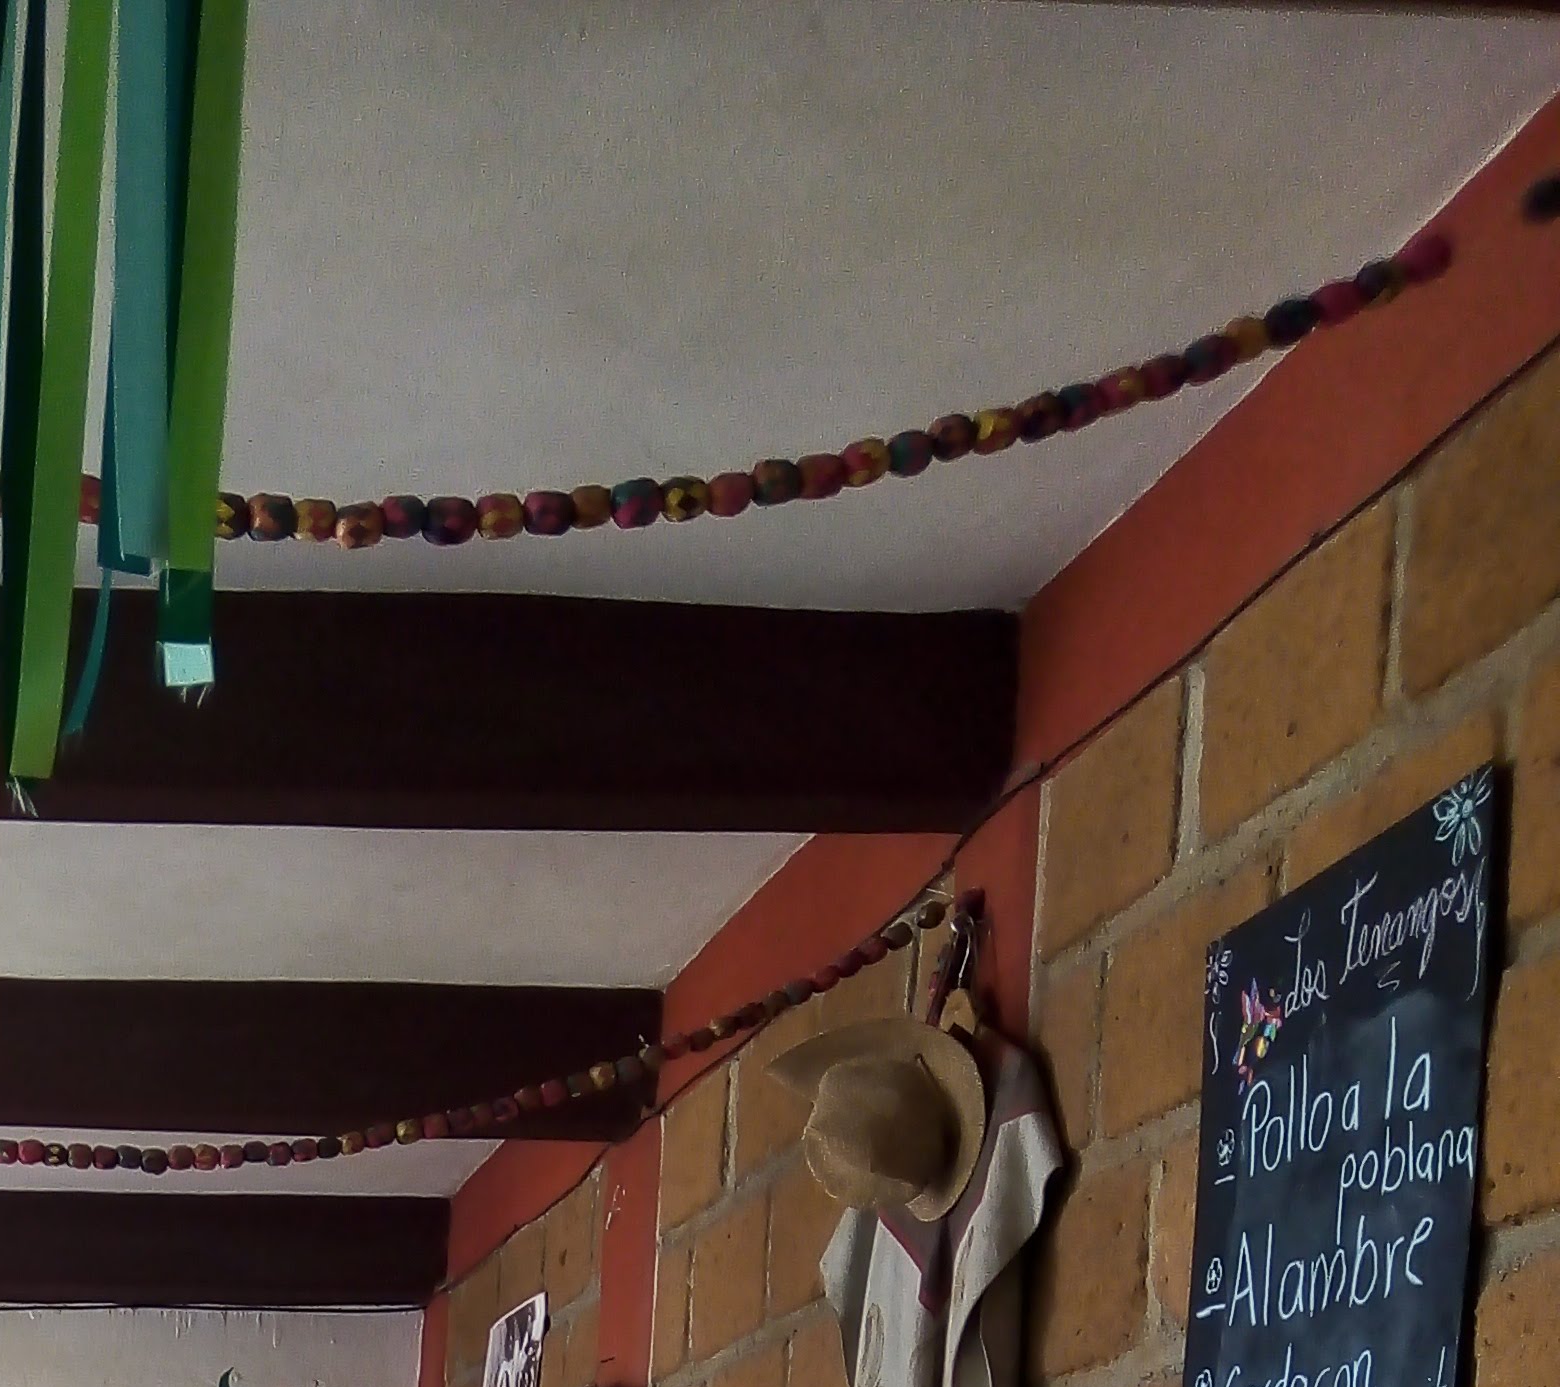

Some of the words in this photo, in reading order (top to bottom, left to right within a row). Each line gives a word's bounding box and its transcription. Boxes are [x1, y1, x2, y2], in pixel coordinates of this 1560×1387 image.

[1284, 907, 1331, 1019] Los
[1241, 1053, 1333, 1178] Pollo
[1341, 1080, 1361, 1131] a
[1384, 1015, 1431, 1121] la
[1335, 1120, 1475, 1246] poblana
[1228, 1214, 1434, 1328] Alambre
